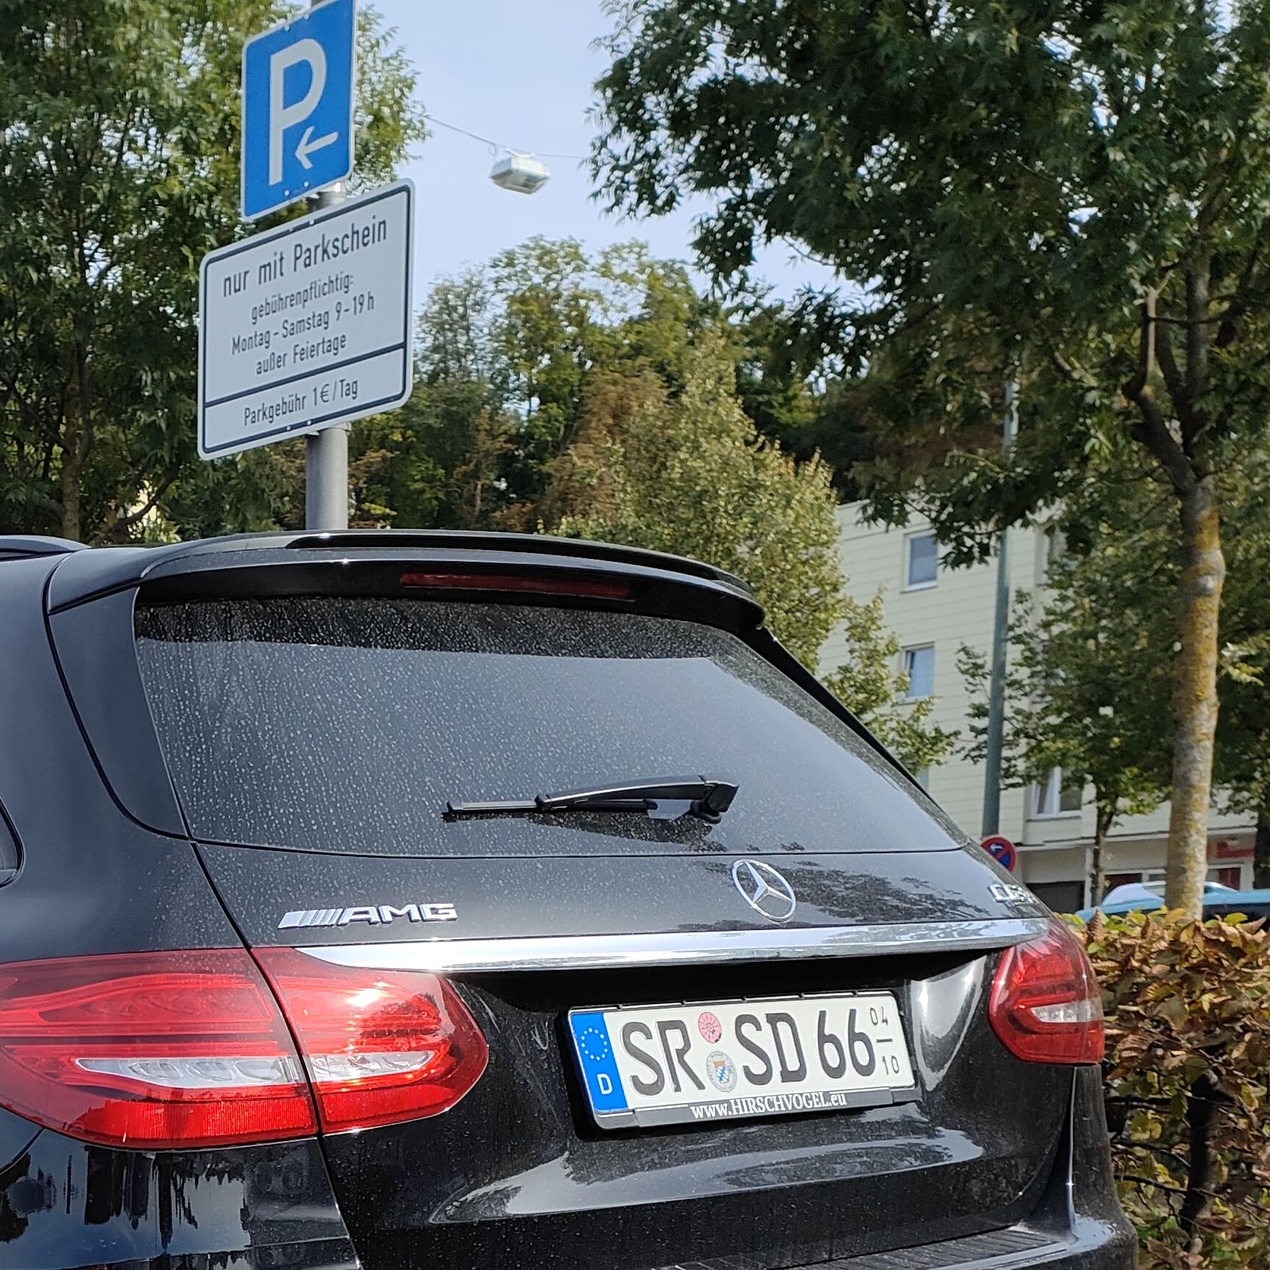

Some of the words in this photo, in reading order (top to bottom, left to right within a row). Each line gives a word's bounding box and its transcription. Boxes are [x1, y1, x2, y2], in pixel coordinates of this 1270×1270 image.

[268, 38, 327, 186] P
[223, 269, 249, 297] nur
[258, 252, 284, 285] mit
[293, 215, 387, 272] Parkschein
[251, 271, 354, 325] gebührenpflichtig:
[232, 329, 271, 355] Montag
[282, 311, 330, 338] Samstag
[256, 352, 288, 375] außer
[293, 334, 347, 364] Feiertage
[244, 393, 307, 426] Parkgebühr
[336, 902, 458, 926] AMG
[869, 1006, 889, 1026] 04
[621, 1019, 706, 1096] SR
[734, 1012, 808, 1086] SD
[817, 1008, 877, 1079] 66
[882, 1055, 900, 1076] 10
[596, 1073, 613, 1095] D
[690, 1092, 848, 1119] www.HIRSCHVOGEL.eu
